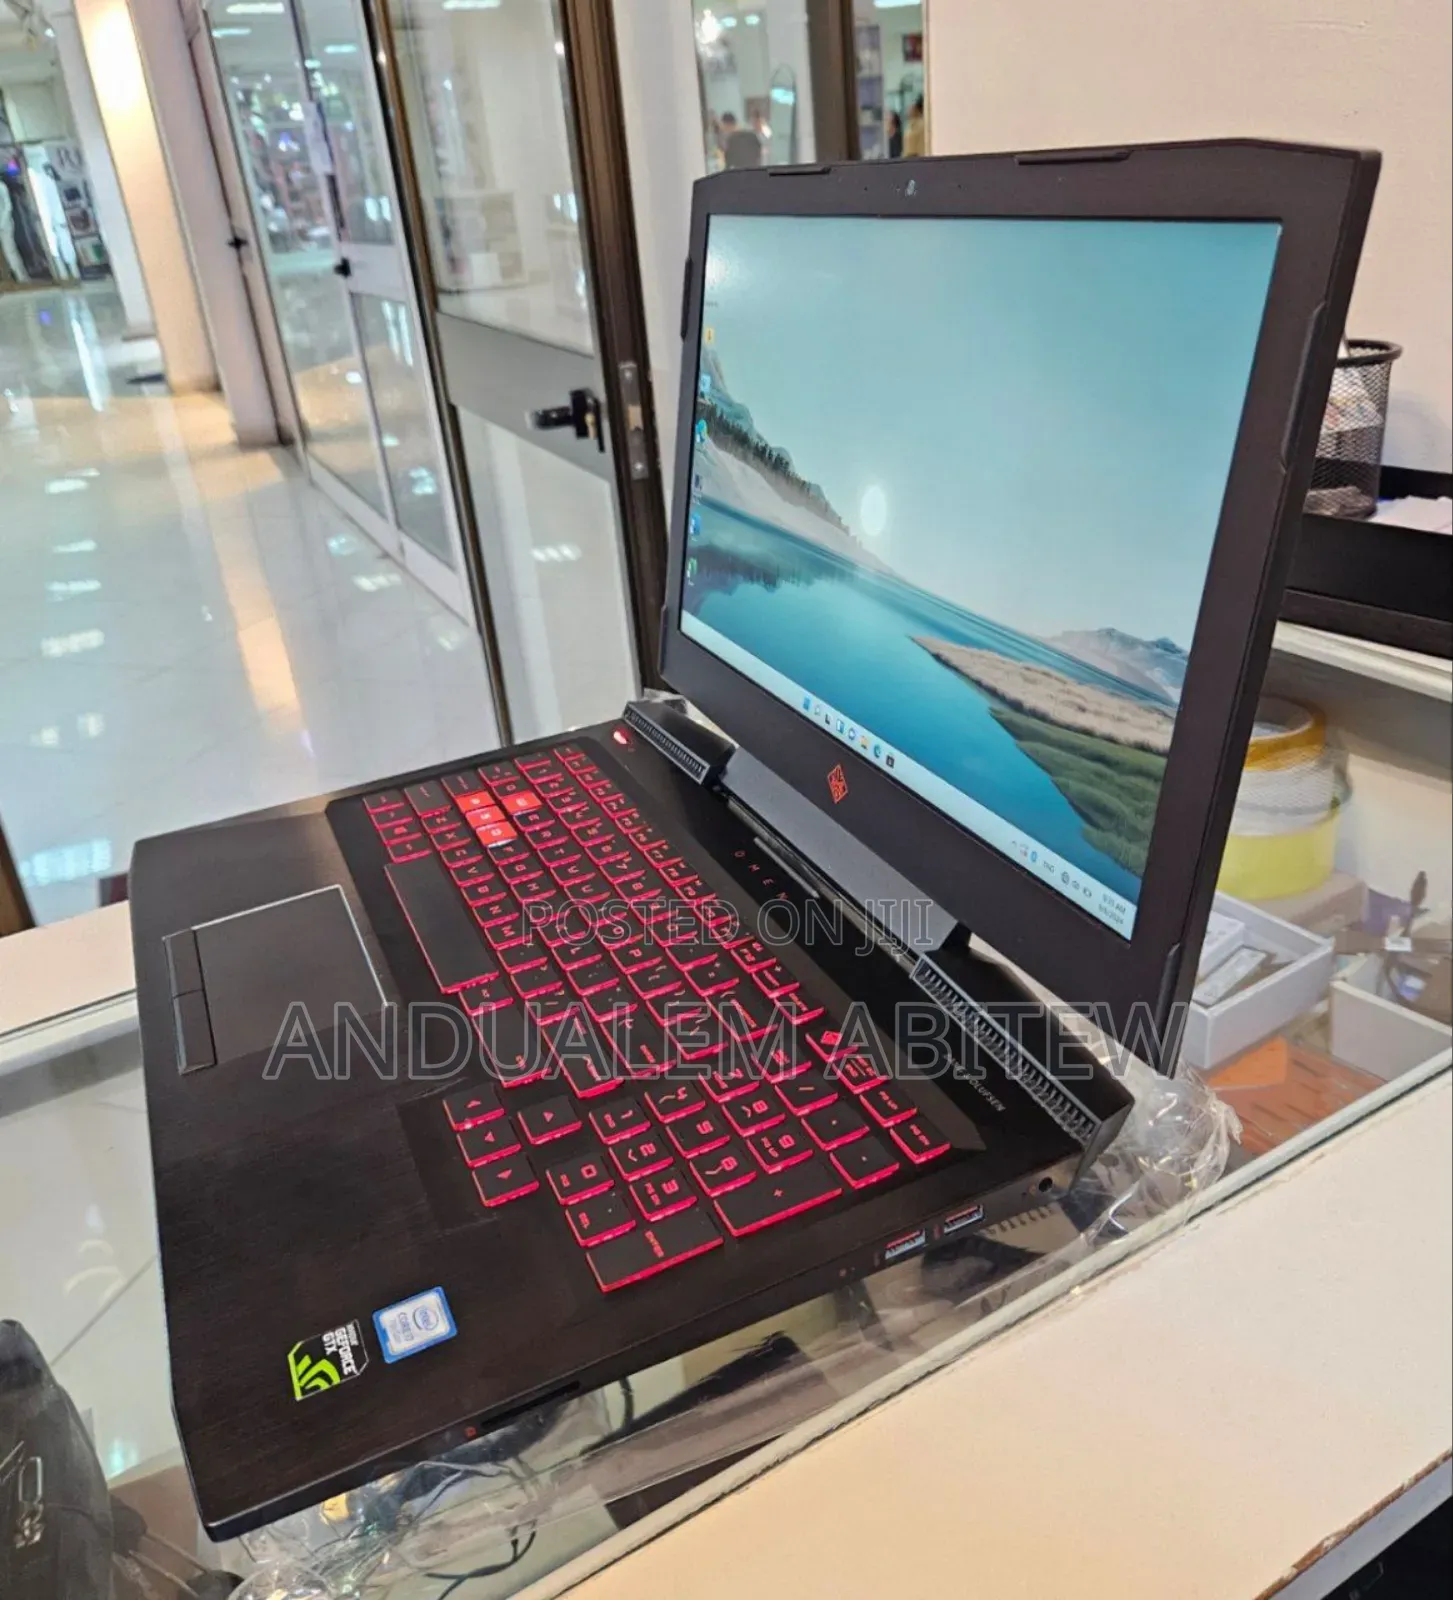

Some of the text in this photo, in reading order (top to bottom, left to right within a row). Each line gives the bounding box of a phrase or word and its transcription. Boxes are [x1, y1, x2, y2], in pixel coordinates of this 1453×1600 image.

[968, 1078, 1007, 1112] OLUFSEN
[321, 1331, 338, 1356] GTX
[334, 1326, 358, 1376] GEFORCE
